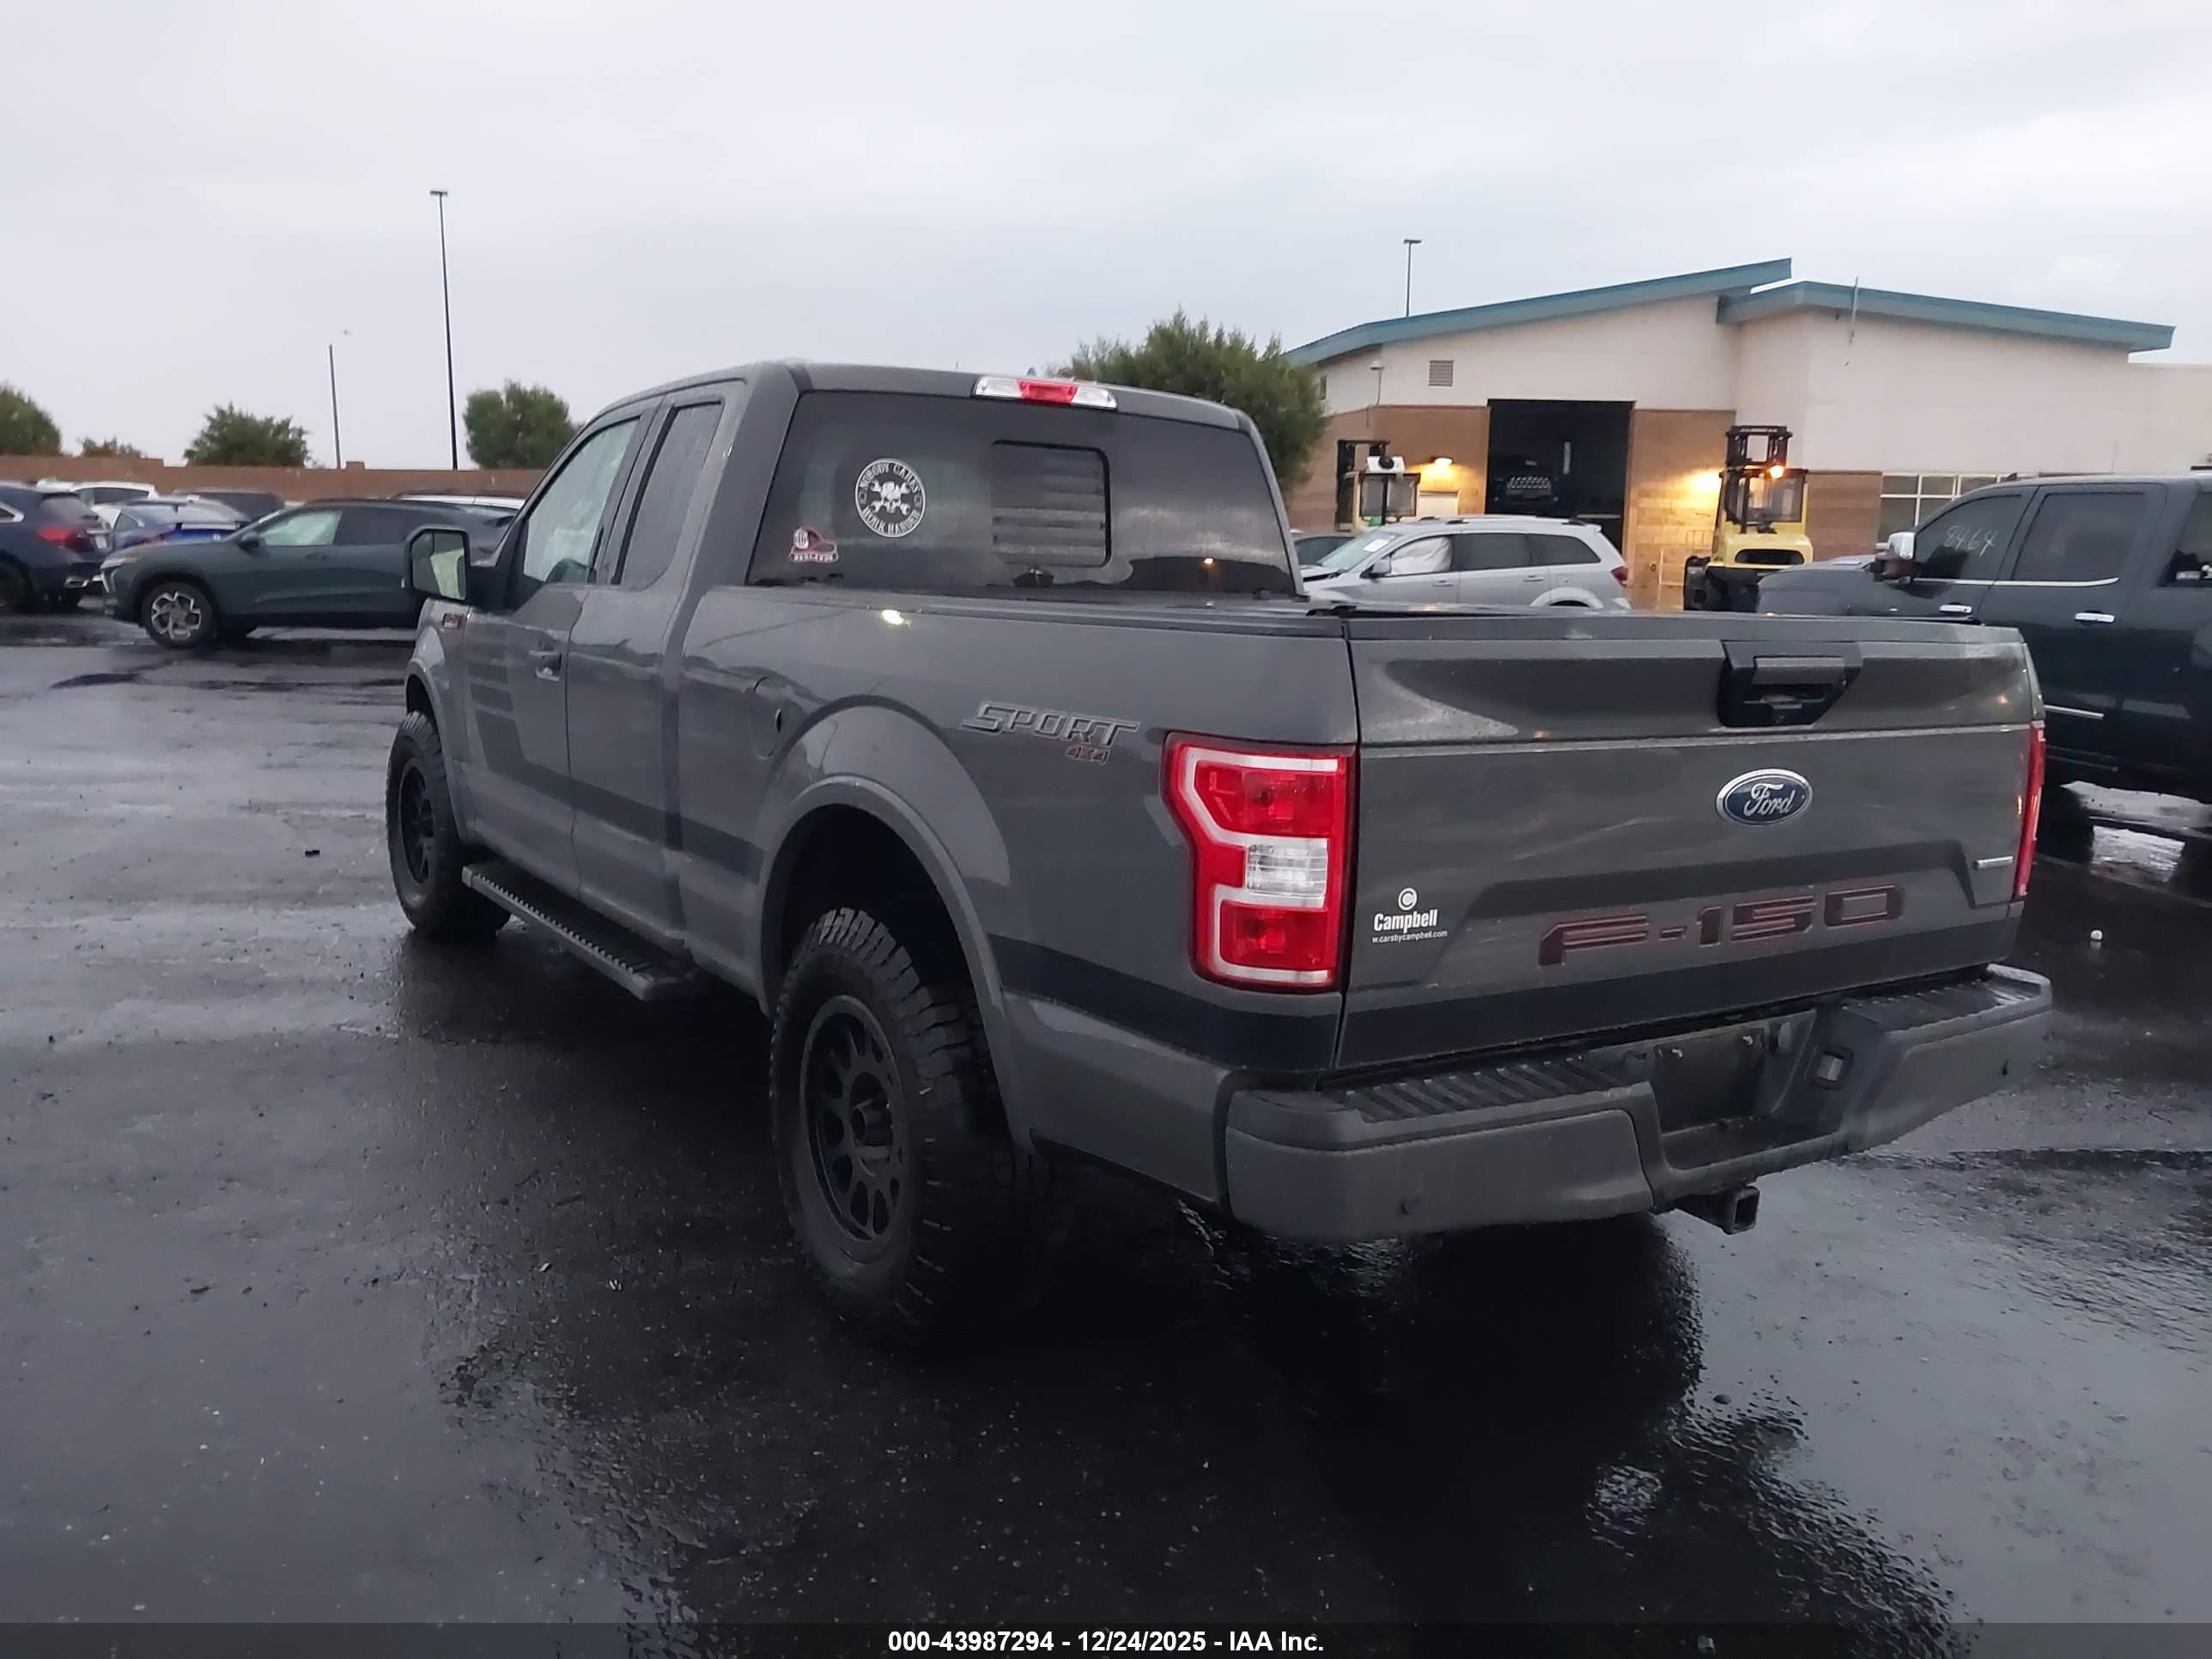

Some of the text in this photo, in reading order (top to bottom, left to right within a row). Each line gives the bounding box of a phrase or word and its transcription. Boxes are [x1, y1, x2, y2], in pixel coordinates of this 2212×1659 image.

[962, 701, 1141, 748] SPORT
[1743, 782, 1796, 817] Ford
[1374, 908, 1437, 933] Campbell
[1538, 884, 1905, 968] F-150
